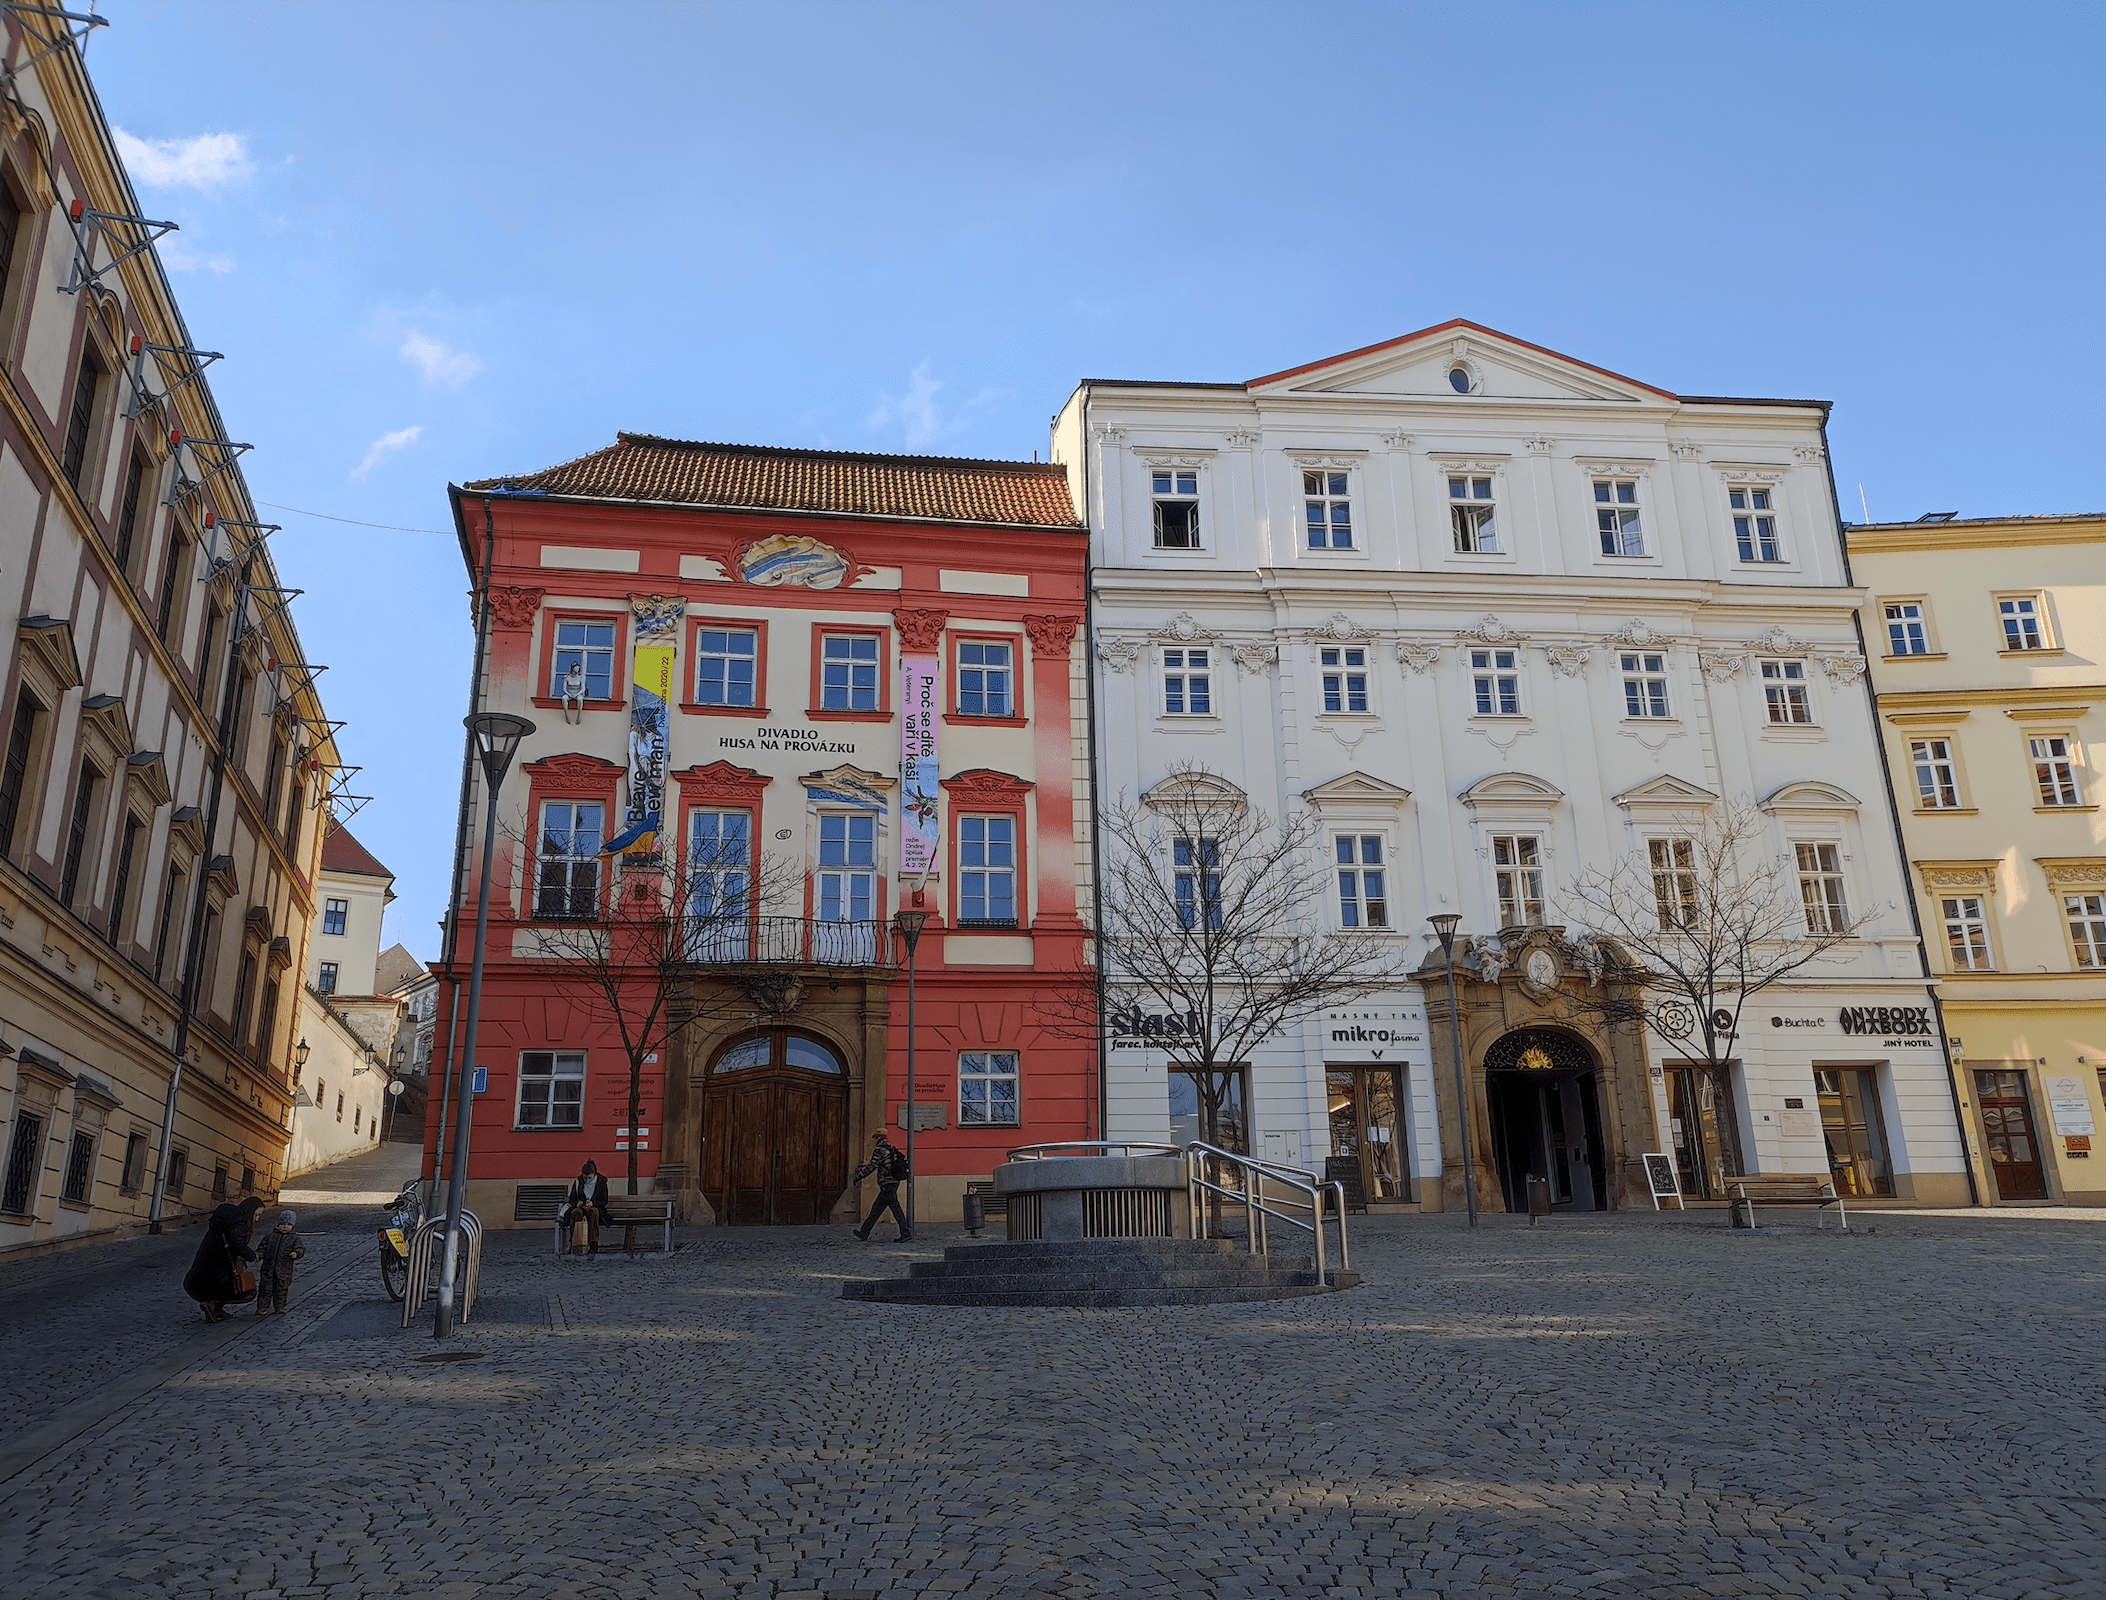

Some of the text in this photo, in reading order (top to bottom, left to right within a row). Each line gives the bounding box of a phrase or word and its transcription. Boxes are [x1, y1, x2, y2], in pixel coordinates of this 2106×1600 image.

[659, 656, 670, 687] 2020/22
[920, 675, 934, 757] Proč se dítě
[719, 738, 854, 753] HUSA NA PROVÁZKU
[758, 728, 818, 740] DIVADLO
[905, 714, 919, 780] vaří v kaši
[648, 737, 665, 779] man
[627, 771, 646, 822] Brave
[1784, 1017, 1816, 1028] Buchta
[1882, 1038, 1902, 1047] JINÝ
